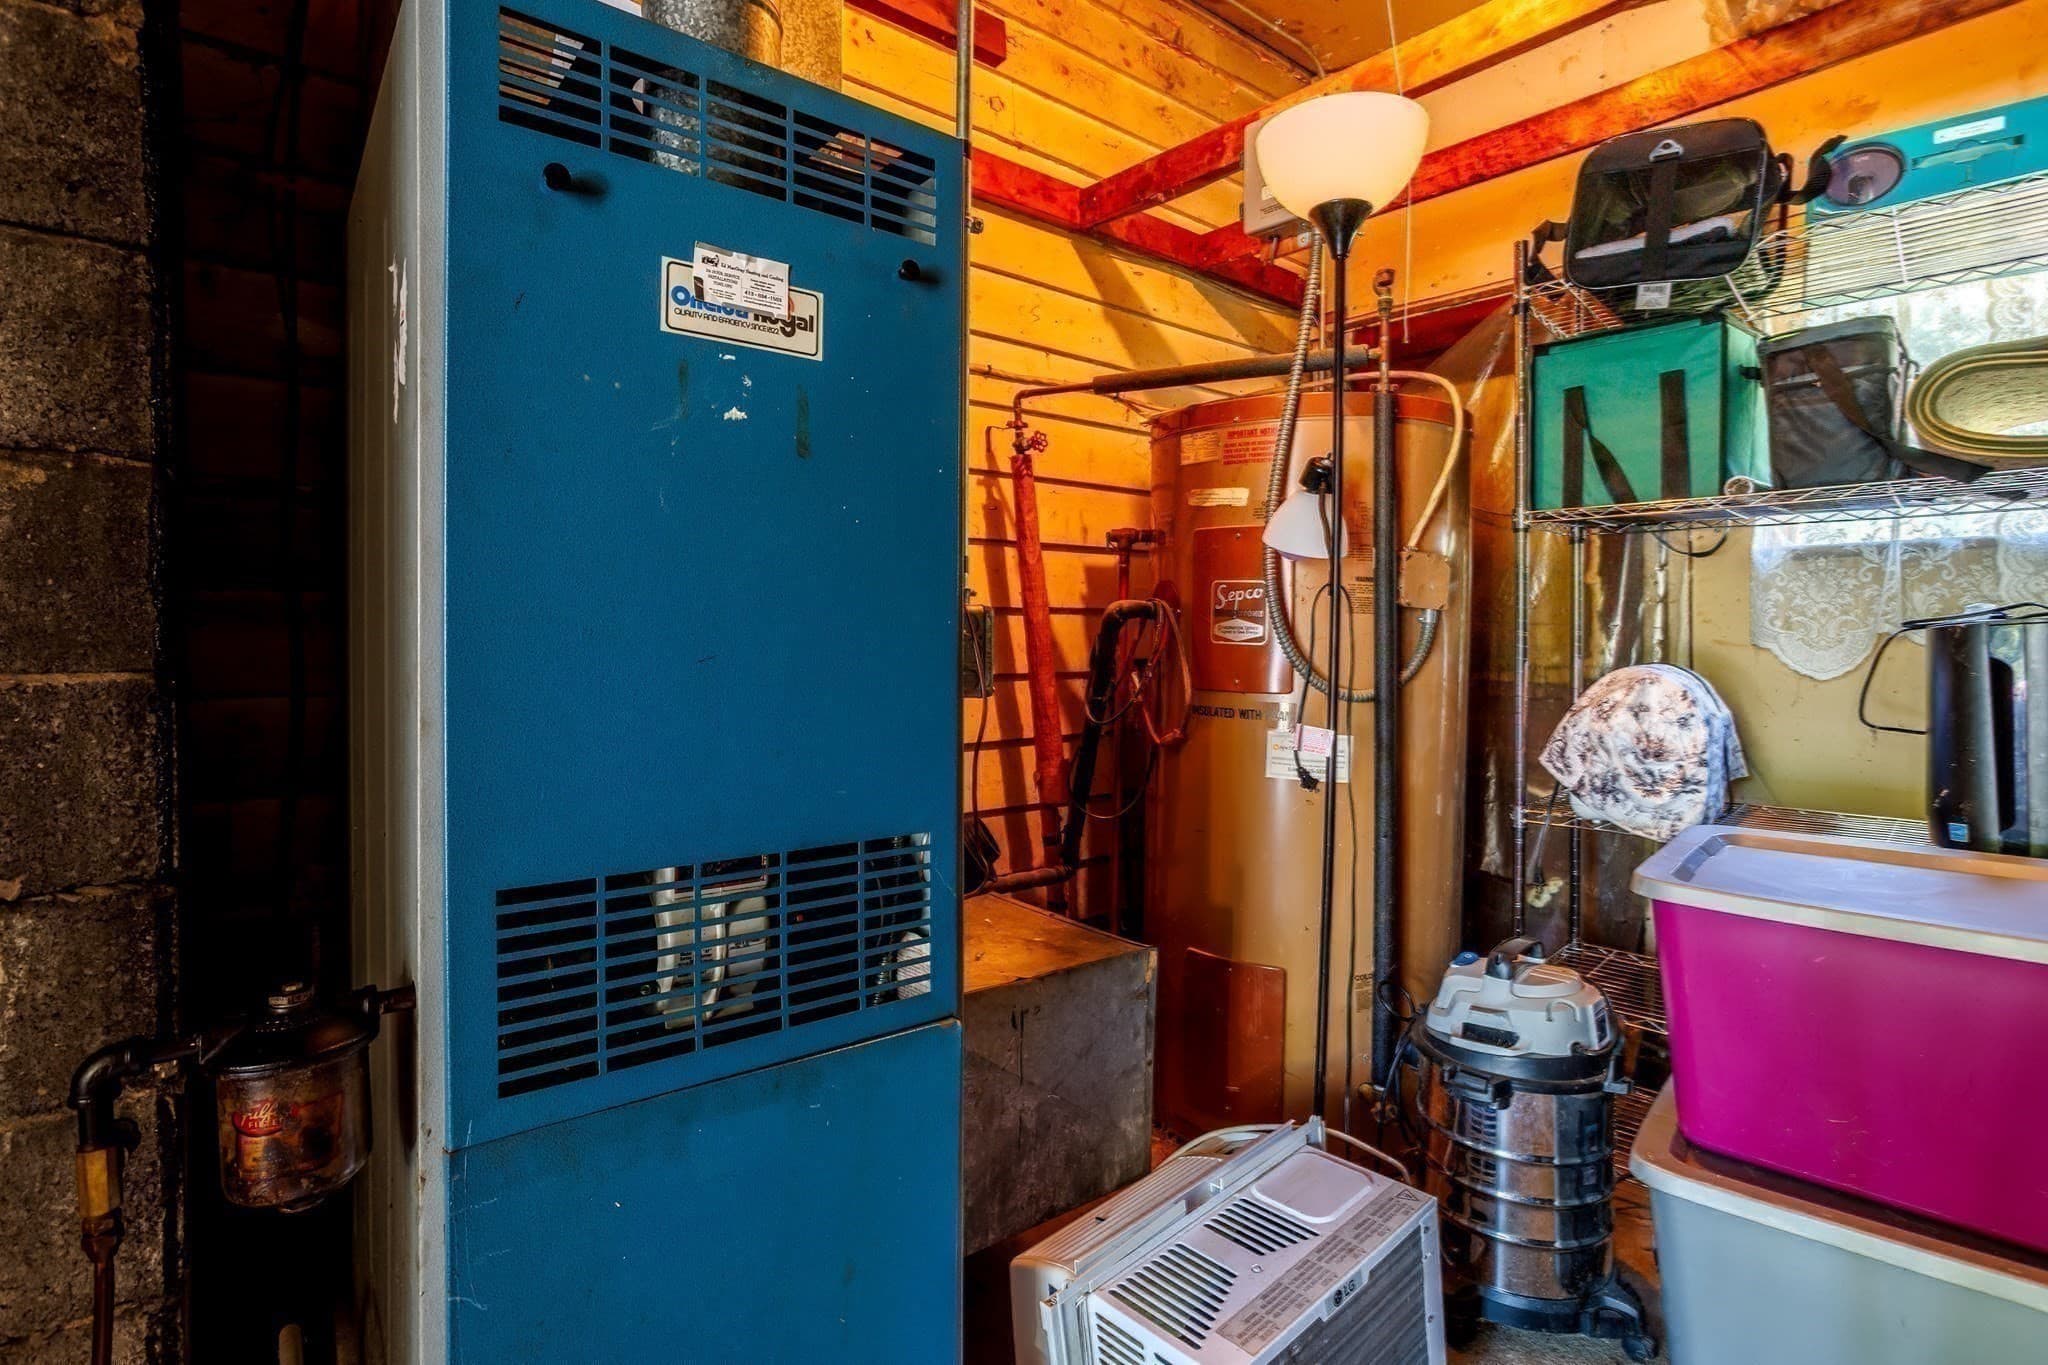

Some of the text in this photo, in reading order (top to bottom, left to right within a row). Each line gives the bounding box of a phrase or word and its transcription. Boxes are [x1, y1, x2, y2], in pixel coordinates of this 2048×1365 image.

[769, 274, 784, 283] Cooling
[673, 307, 703, 319] QUALITY
[703, 313, 718, 323] AND
[718, 316, 751, 329] EFFICIENCY
[751, 322, 767, 333] SINCE
[1215, 584, 1264, 610] Sepco
[1191, 705, 1235, 719] INSULATED
[1238, 708, 1262, 720] WITH
[1343, 1279, 1355, 1297] LG
